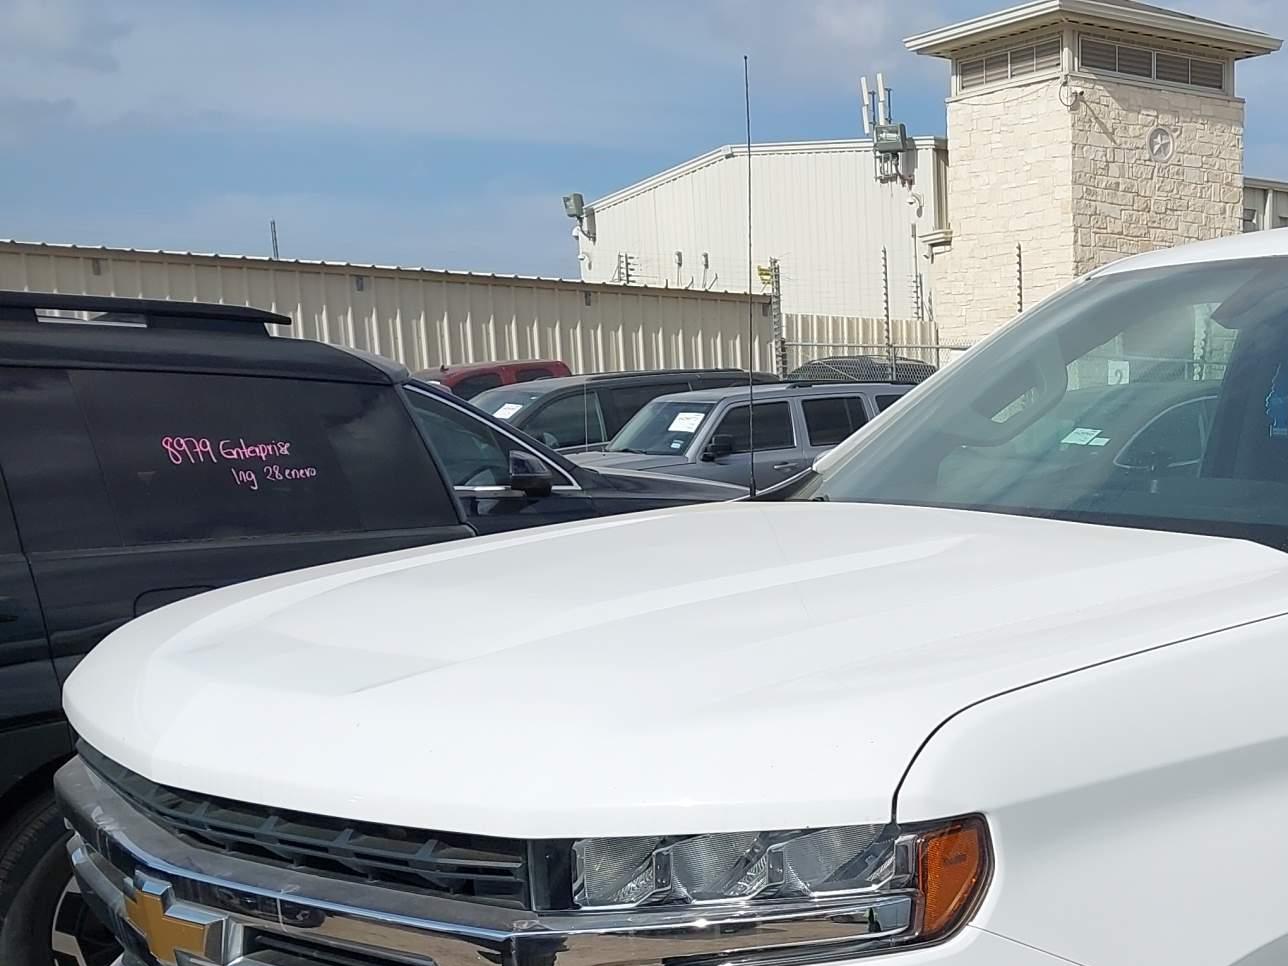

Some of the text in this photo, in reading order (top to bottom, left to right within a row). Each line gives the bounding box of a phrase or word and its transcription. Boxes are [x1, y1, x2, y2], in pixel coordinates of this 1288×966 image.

[161, 436, 291, 464] 8979 Enterprise
[263, 465, 283, 481] 28
[284, 467, 317, 480] enero
